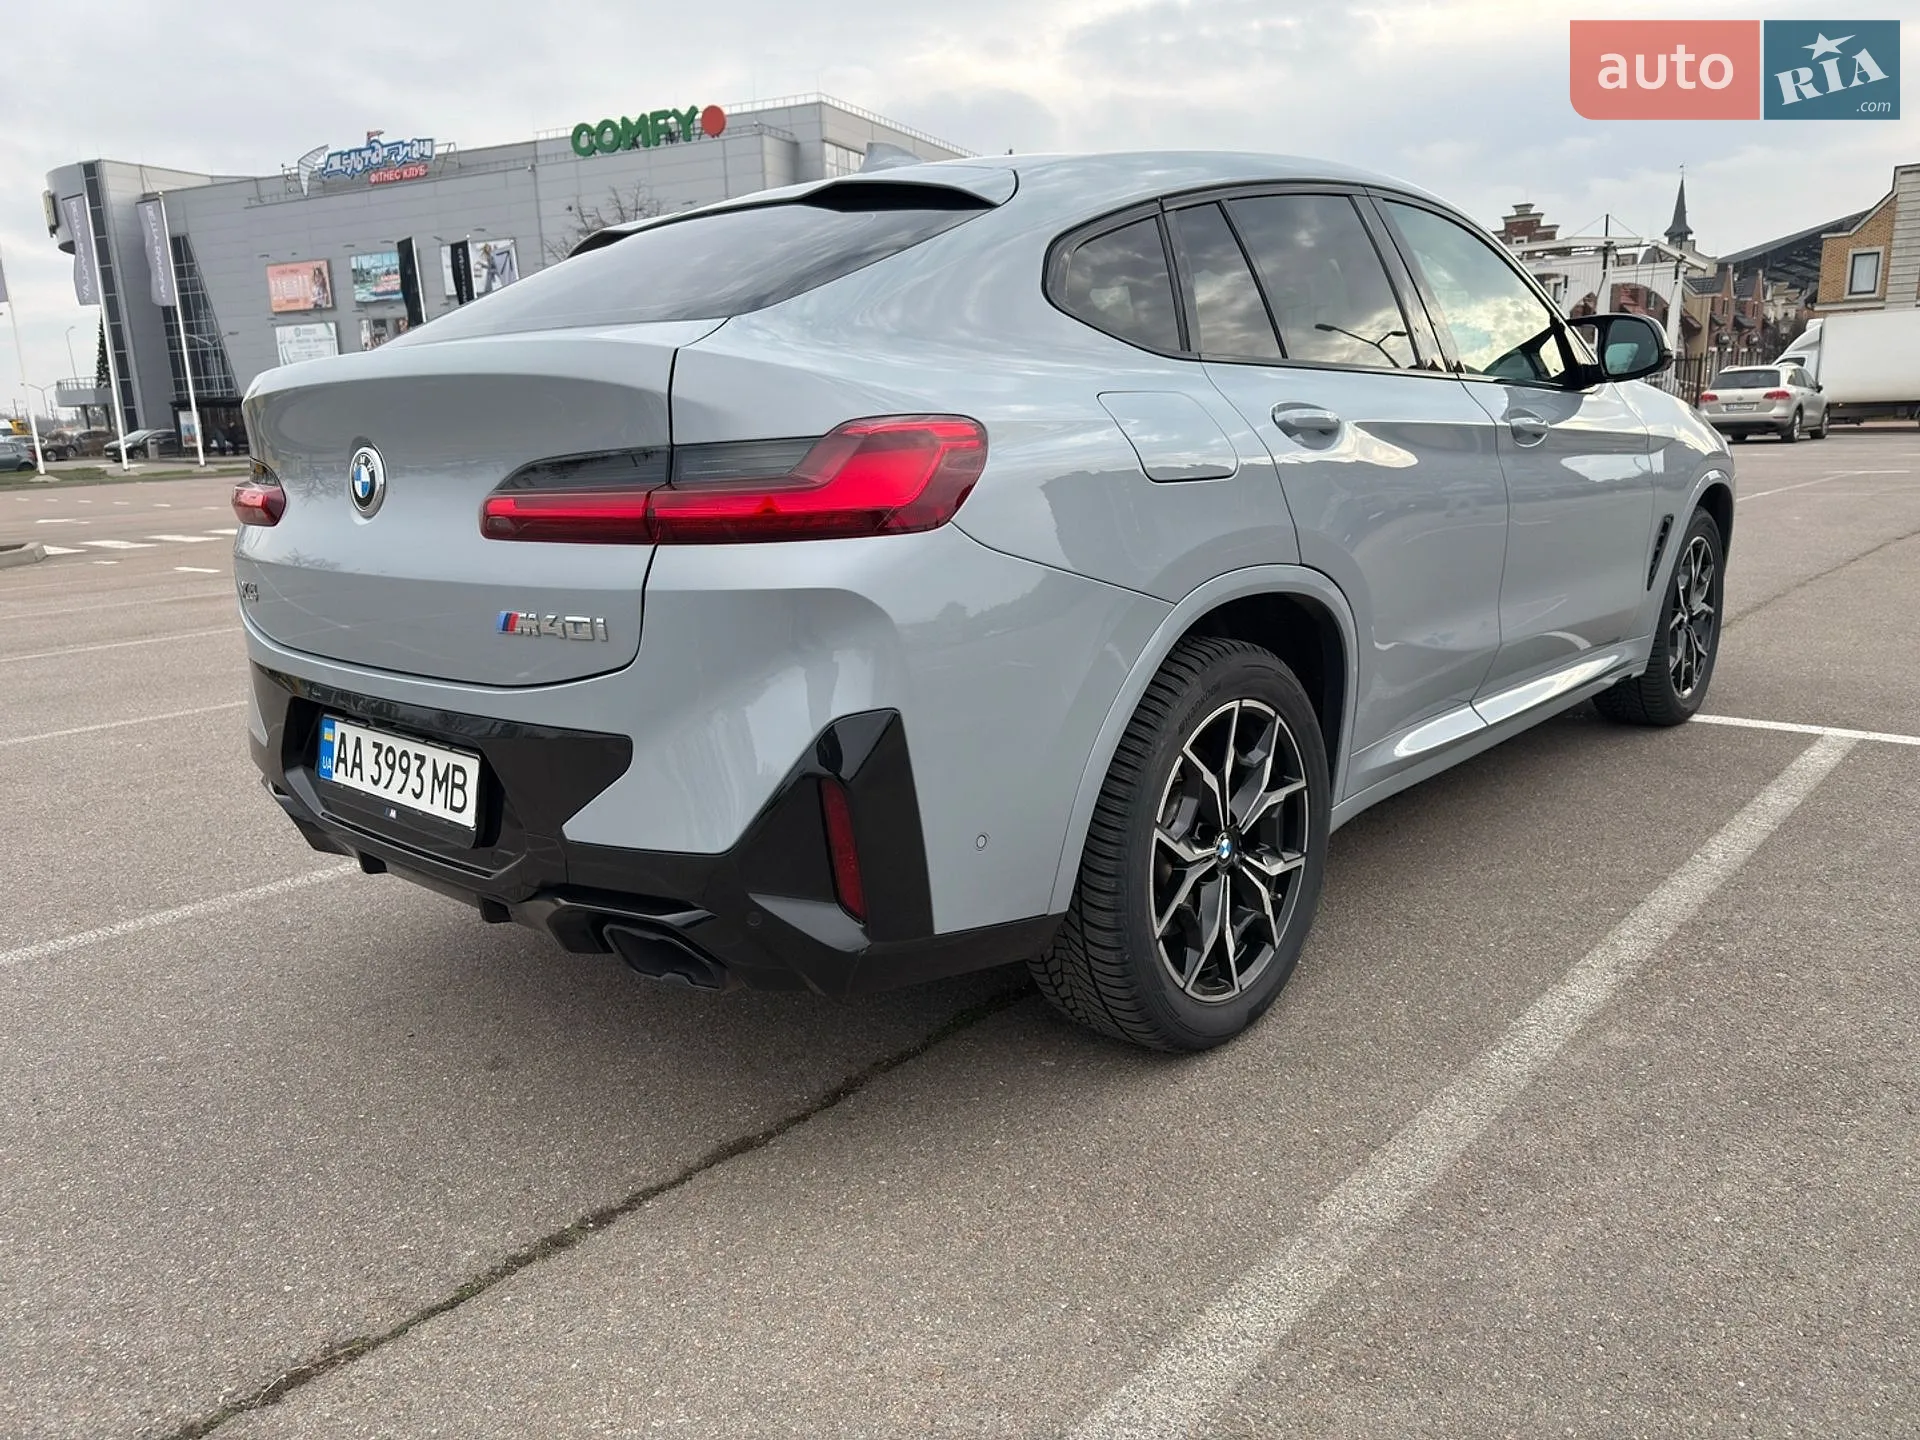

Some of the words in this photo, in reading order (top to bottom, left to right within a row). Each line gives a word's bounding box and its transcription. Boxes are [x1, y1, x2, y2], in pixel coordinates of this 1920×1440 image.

[571, 105, 699, 157] COMFY
[402, 164, 427, 179] КЛУБ
[517, 611, 608, 642] M40i
[321, 755, 332, 771] UA
[334, 731, 364, 783] AA
[370, 741, 426, 800] 3993
[430, 757, 468, 814] MB
